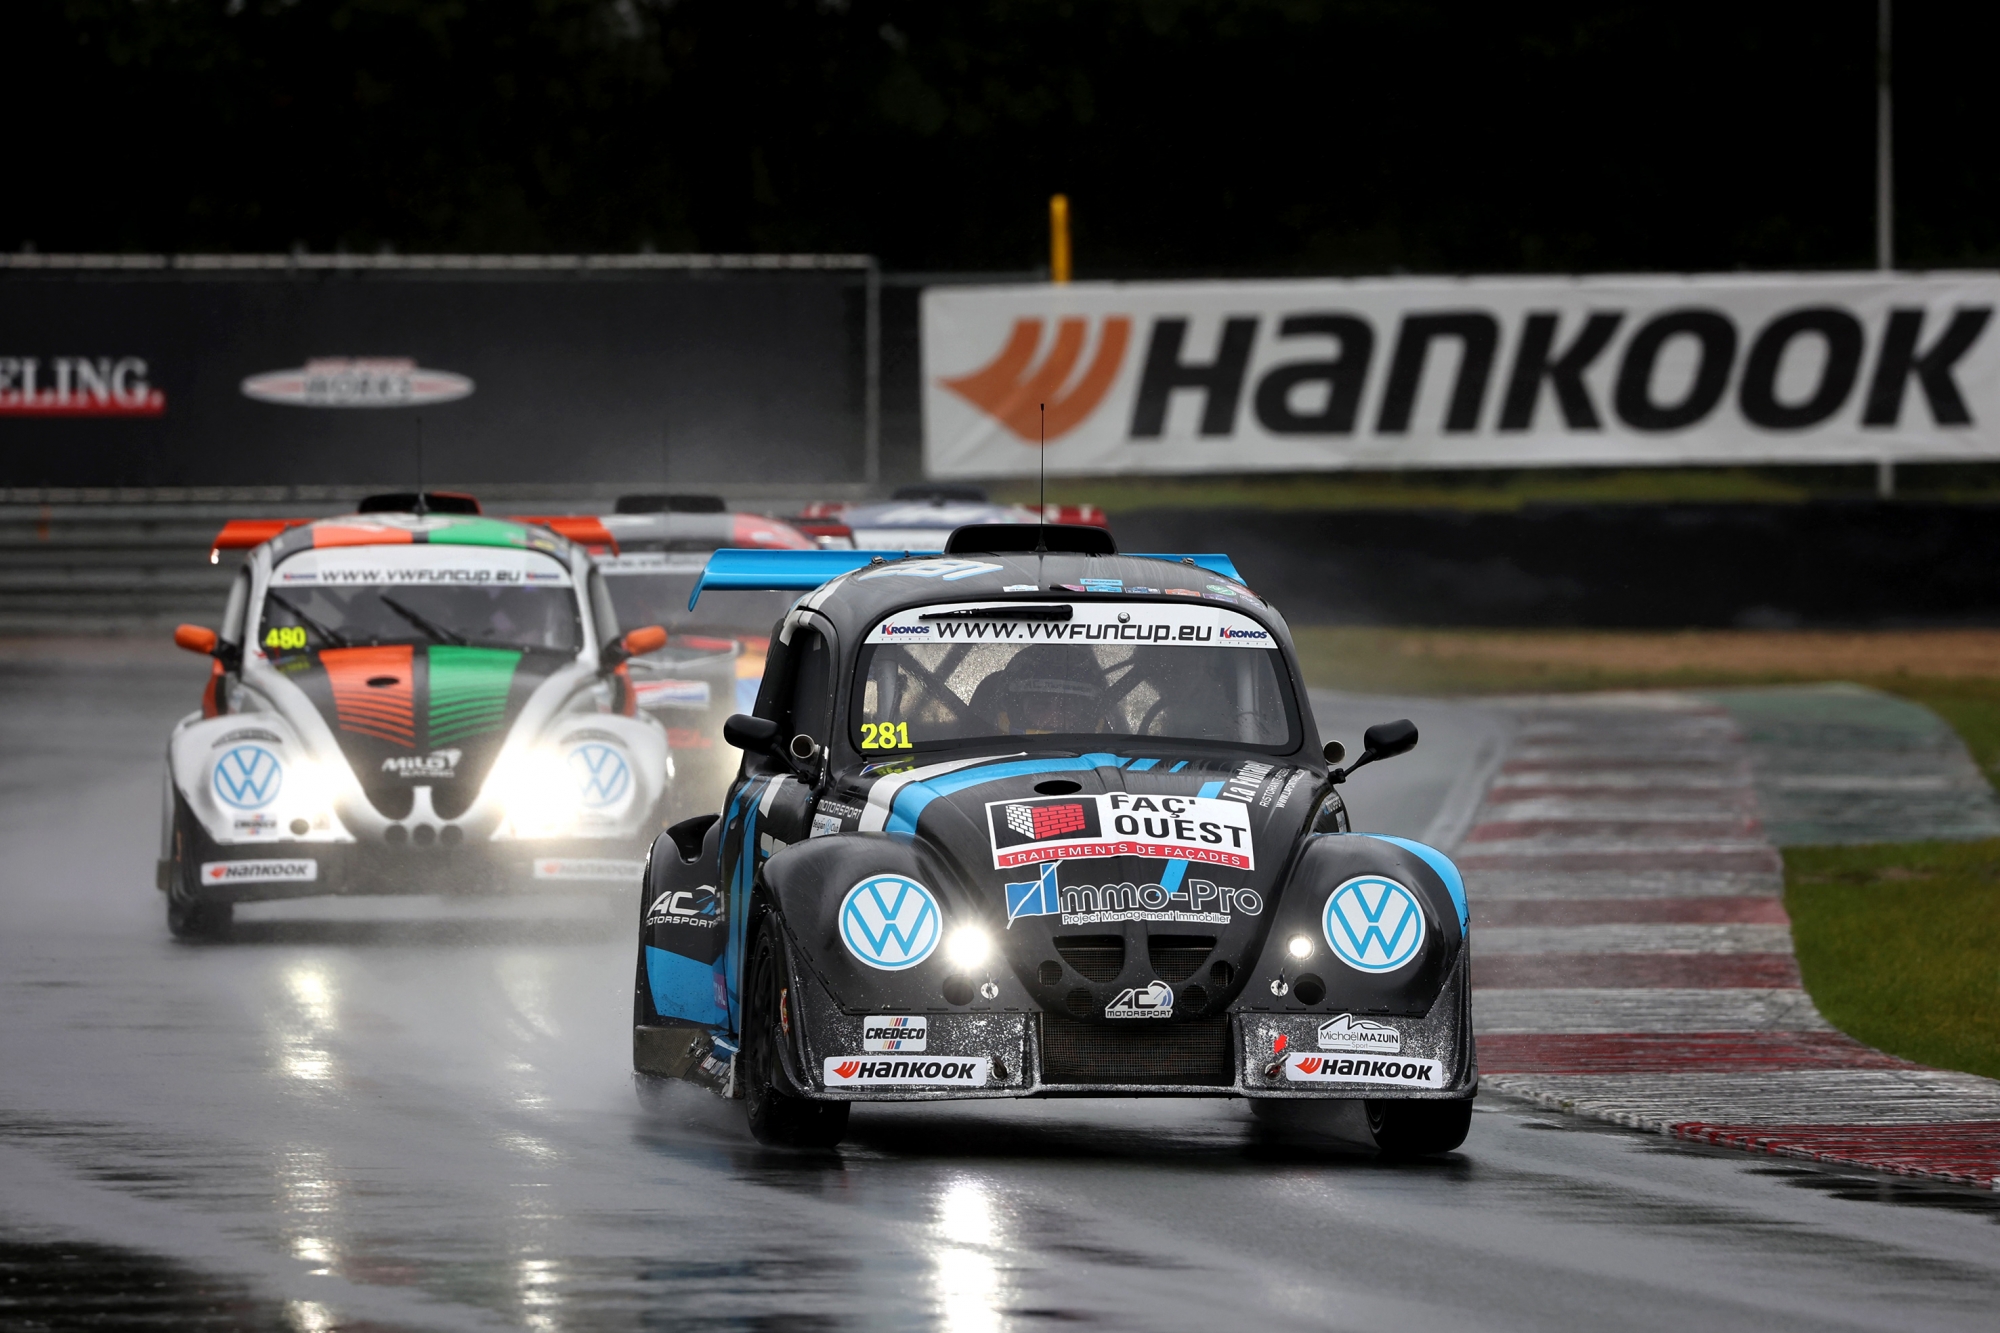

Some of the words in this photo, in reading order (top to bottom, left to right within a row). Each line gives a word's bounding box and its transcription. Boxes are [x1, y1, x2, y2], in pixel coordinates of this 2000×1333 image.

[265, 626, 306, 649] 480
[881, 622, 930, 635] KRONOS
[1219, 625, 1268, 638] KRONOS
[860, 722, 913, 749] 281
[1115, 814, 1247, 848] OUEST
[1006, 843, 1128, 865] TRAITEMENTS
[1136, 846, 1156, 855] DE
[1165, 847, 1241, 866] FAÇADES
[647, 891, 700, 916] AC
[1062, 911, 1100, 925] Project
[1102, 910, 1174, 923] Management
[1176, 911, 1230, 924] Immobilier
[1107, 990, 1158, 1009] AC
[865, 1027, 926, 1040] CREDECO
[1351, 1042, 1369, 1050] Sport
